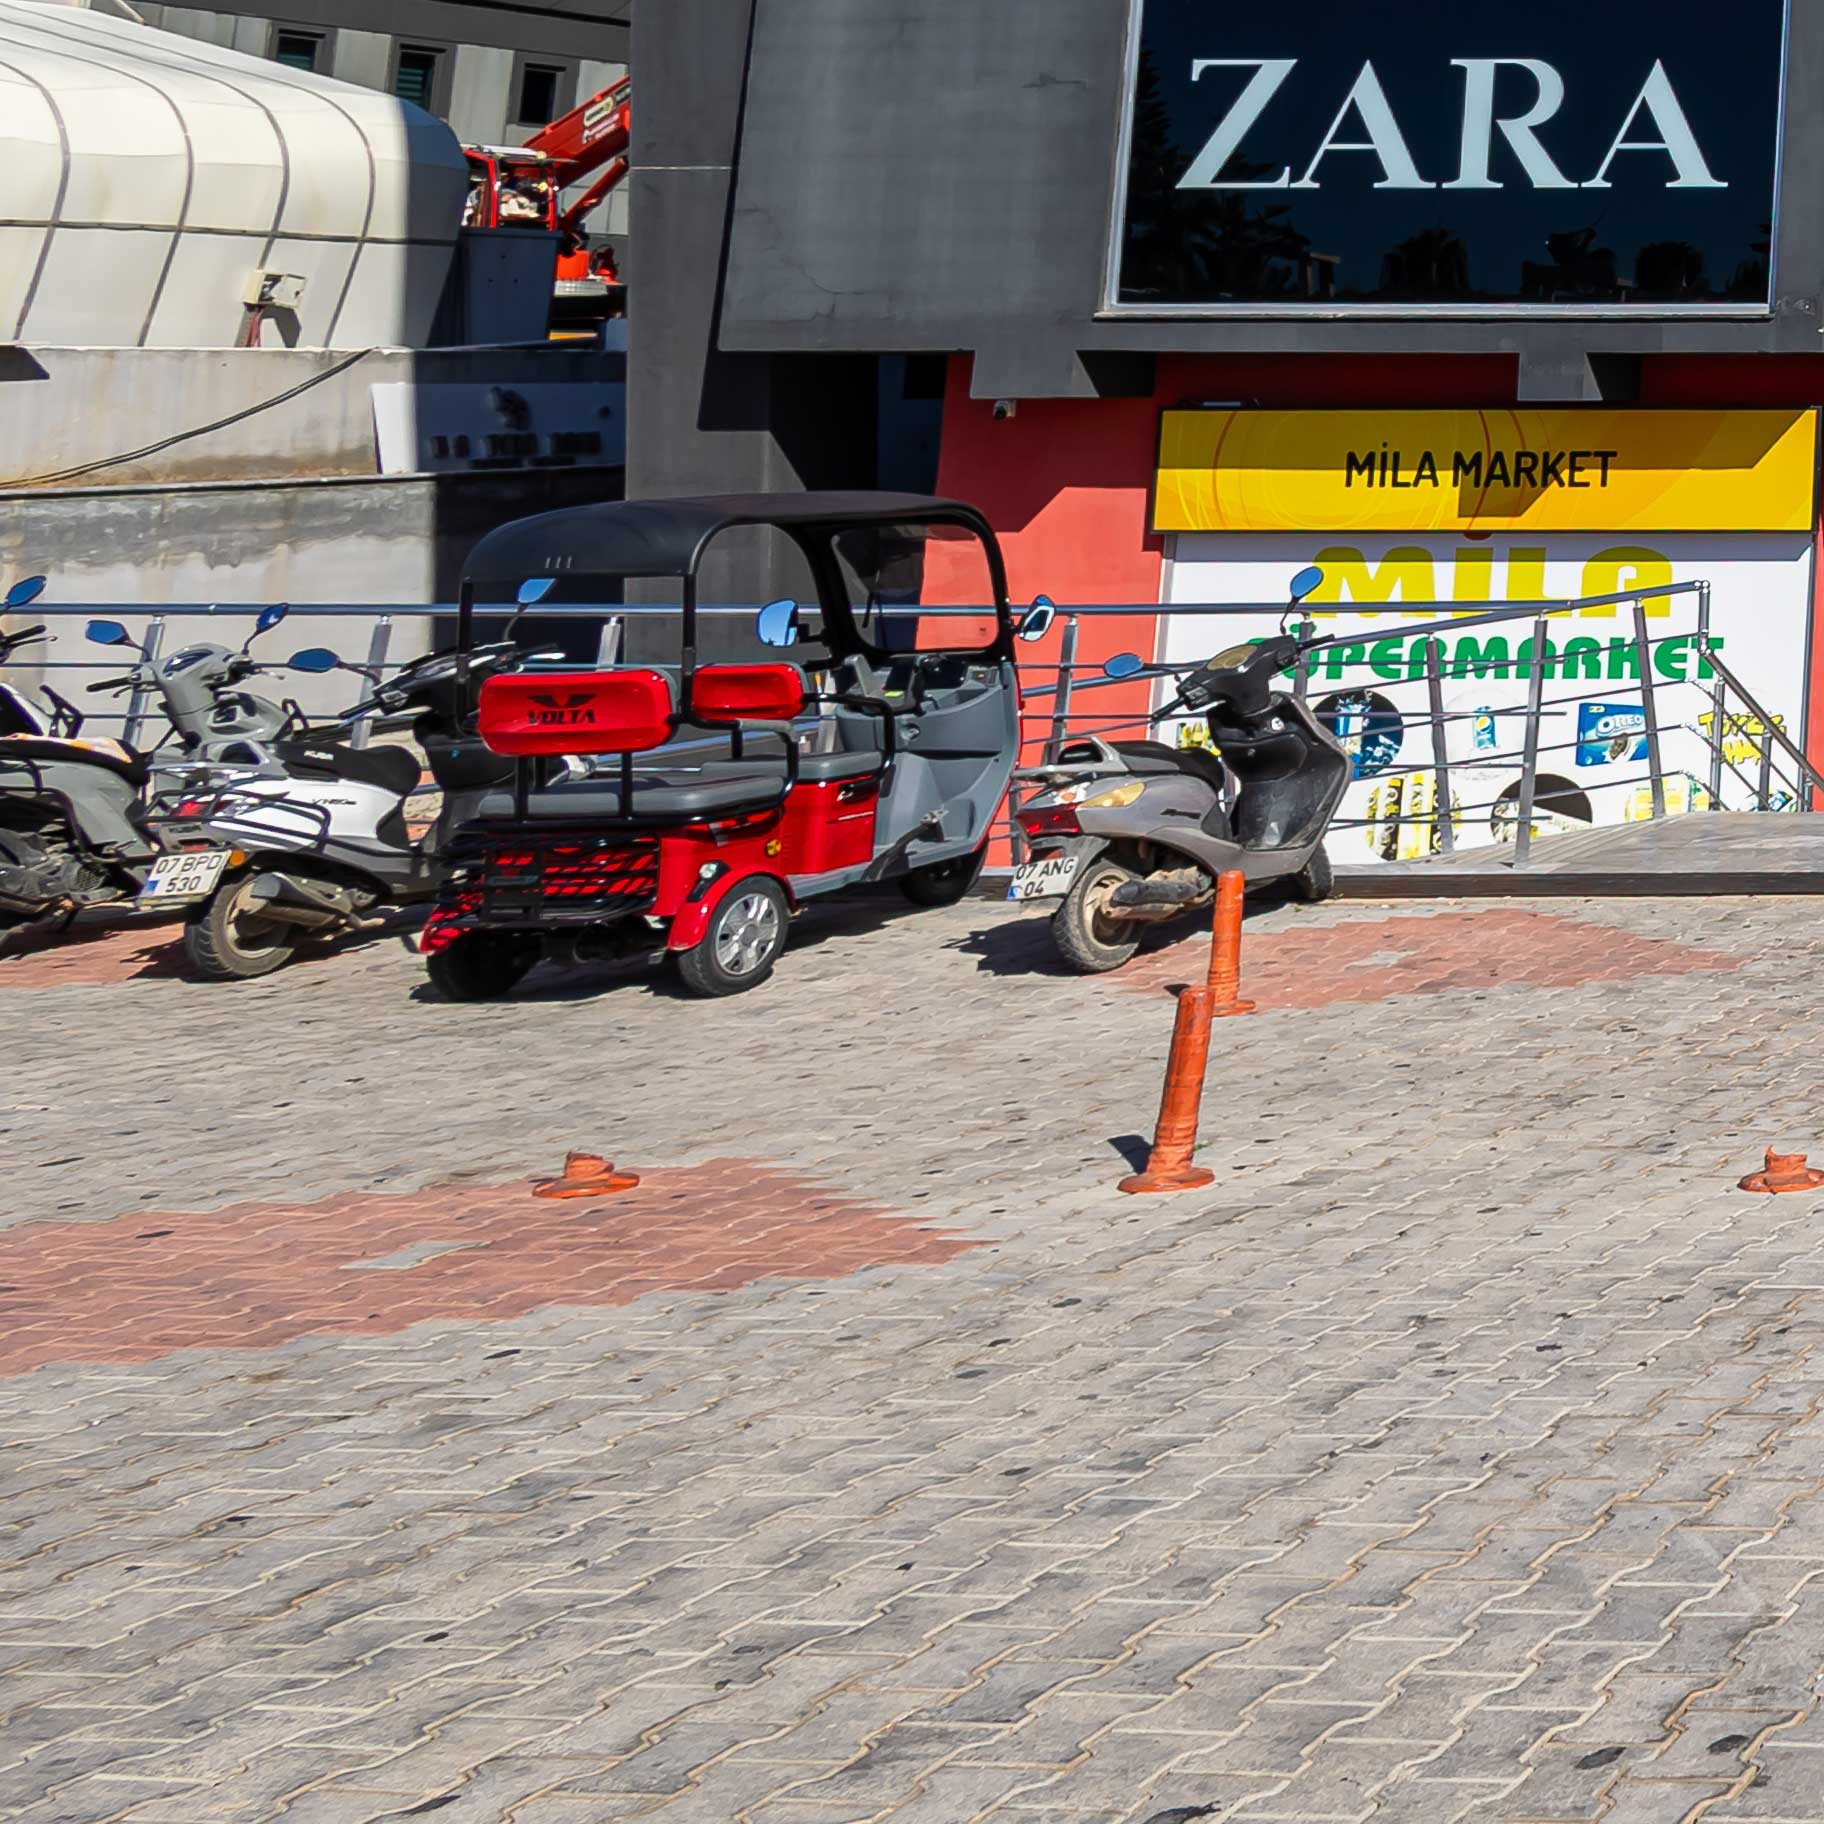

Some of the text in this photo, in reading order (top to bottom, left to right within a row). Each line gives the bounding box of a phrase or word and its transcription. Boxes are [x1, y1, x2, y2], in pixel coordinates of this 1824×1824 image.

[1175, 58, 1728, 189] ZARA
[1345, 442, 1618, 489] MİLA MARKET
[1249, 624, 1725, 680] ÜPERMARKET
[528, 709, 596, 725] VOLTA
[1597, 714, 1643, 733] OREO
[156, 858, 180, 874] 07
[1015, 857, 1075, 880] 07 ANG
[165, 876, 202, 893] 530
[1023, 880, 1045, 898] 04
